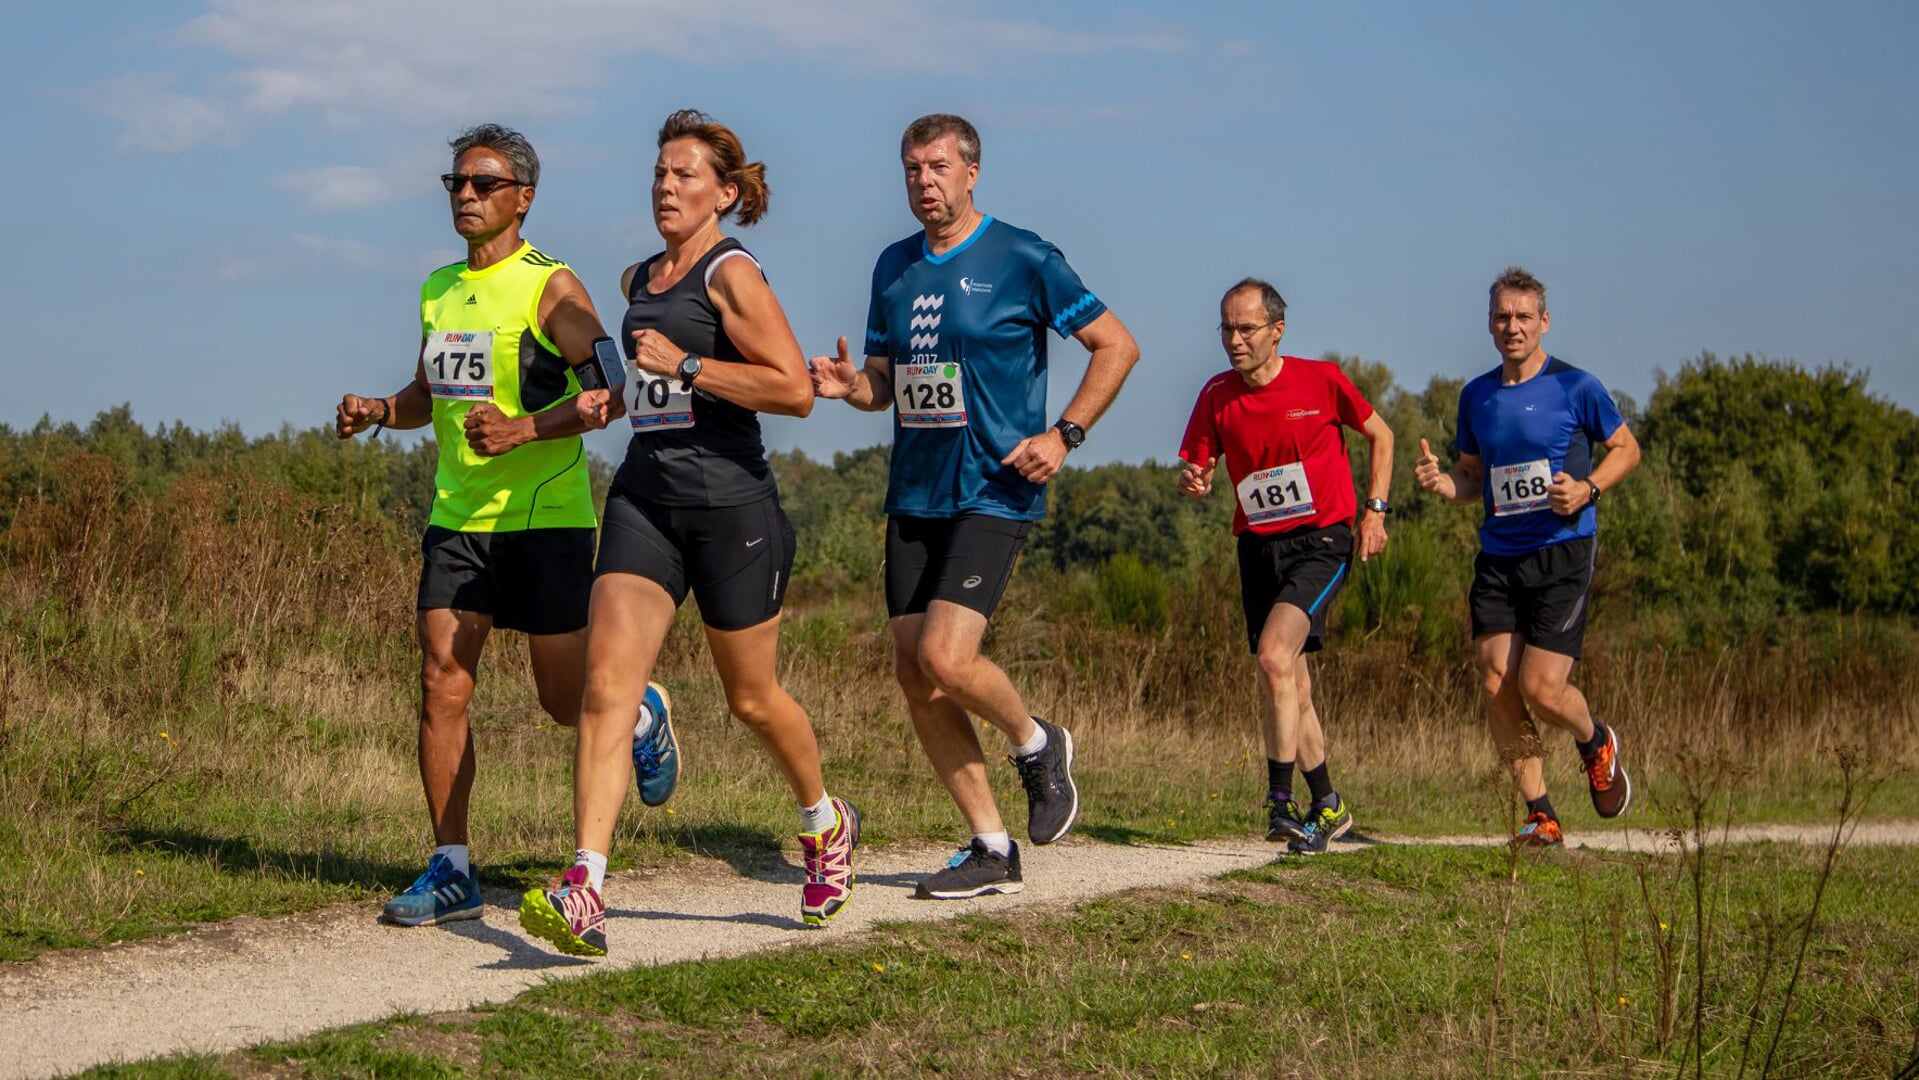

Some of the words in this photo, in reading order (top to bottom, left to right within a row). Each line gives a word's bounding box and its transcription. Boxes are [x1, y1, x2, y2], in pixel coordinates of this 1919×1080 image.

[432, 351, 486, 381] 175
[902, 382, 956, 410] 128
[1248, 479, 1302, 509] 181
[1500, 476, 1548, 501] 168
